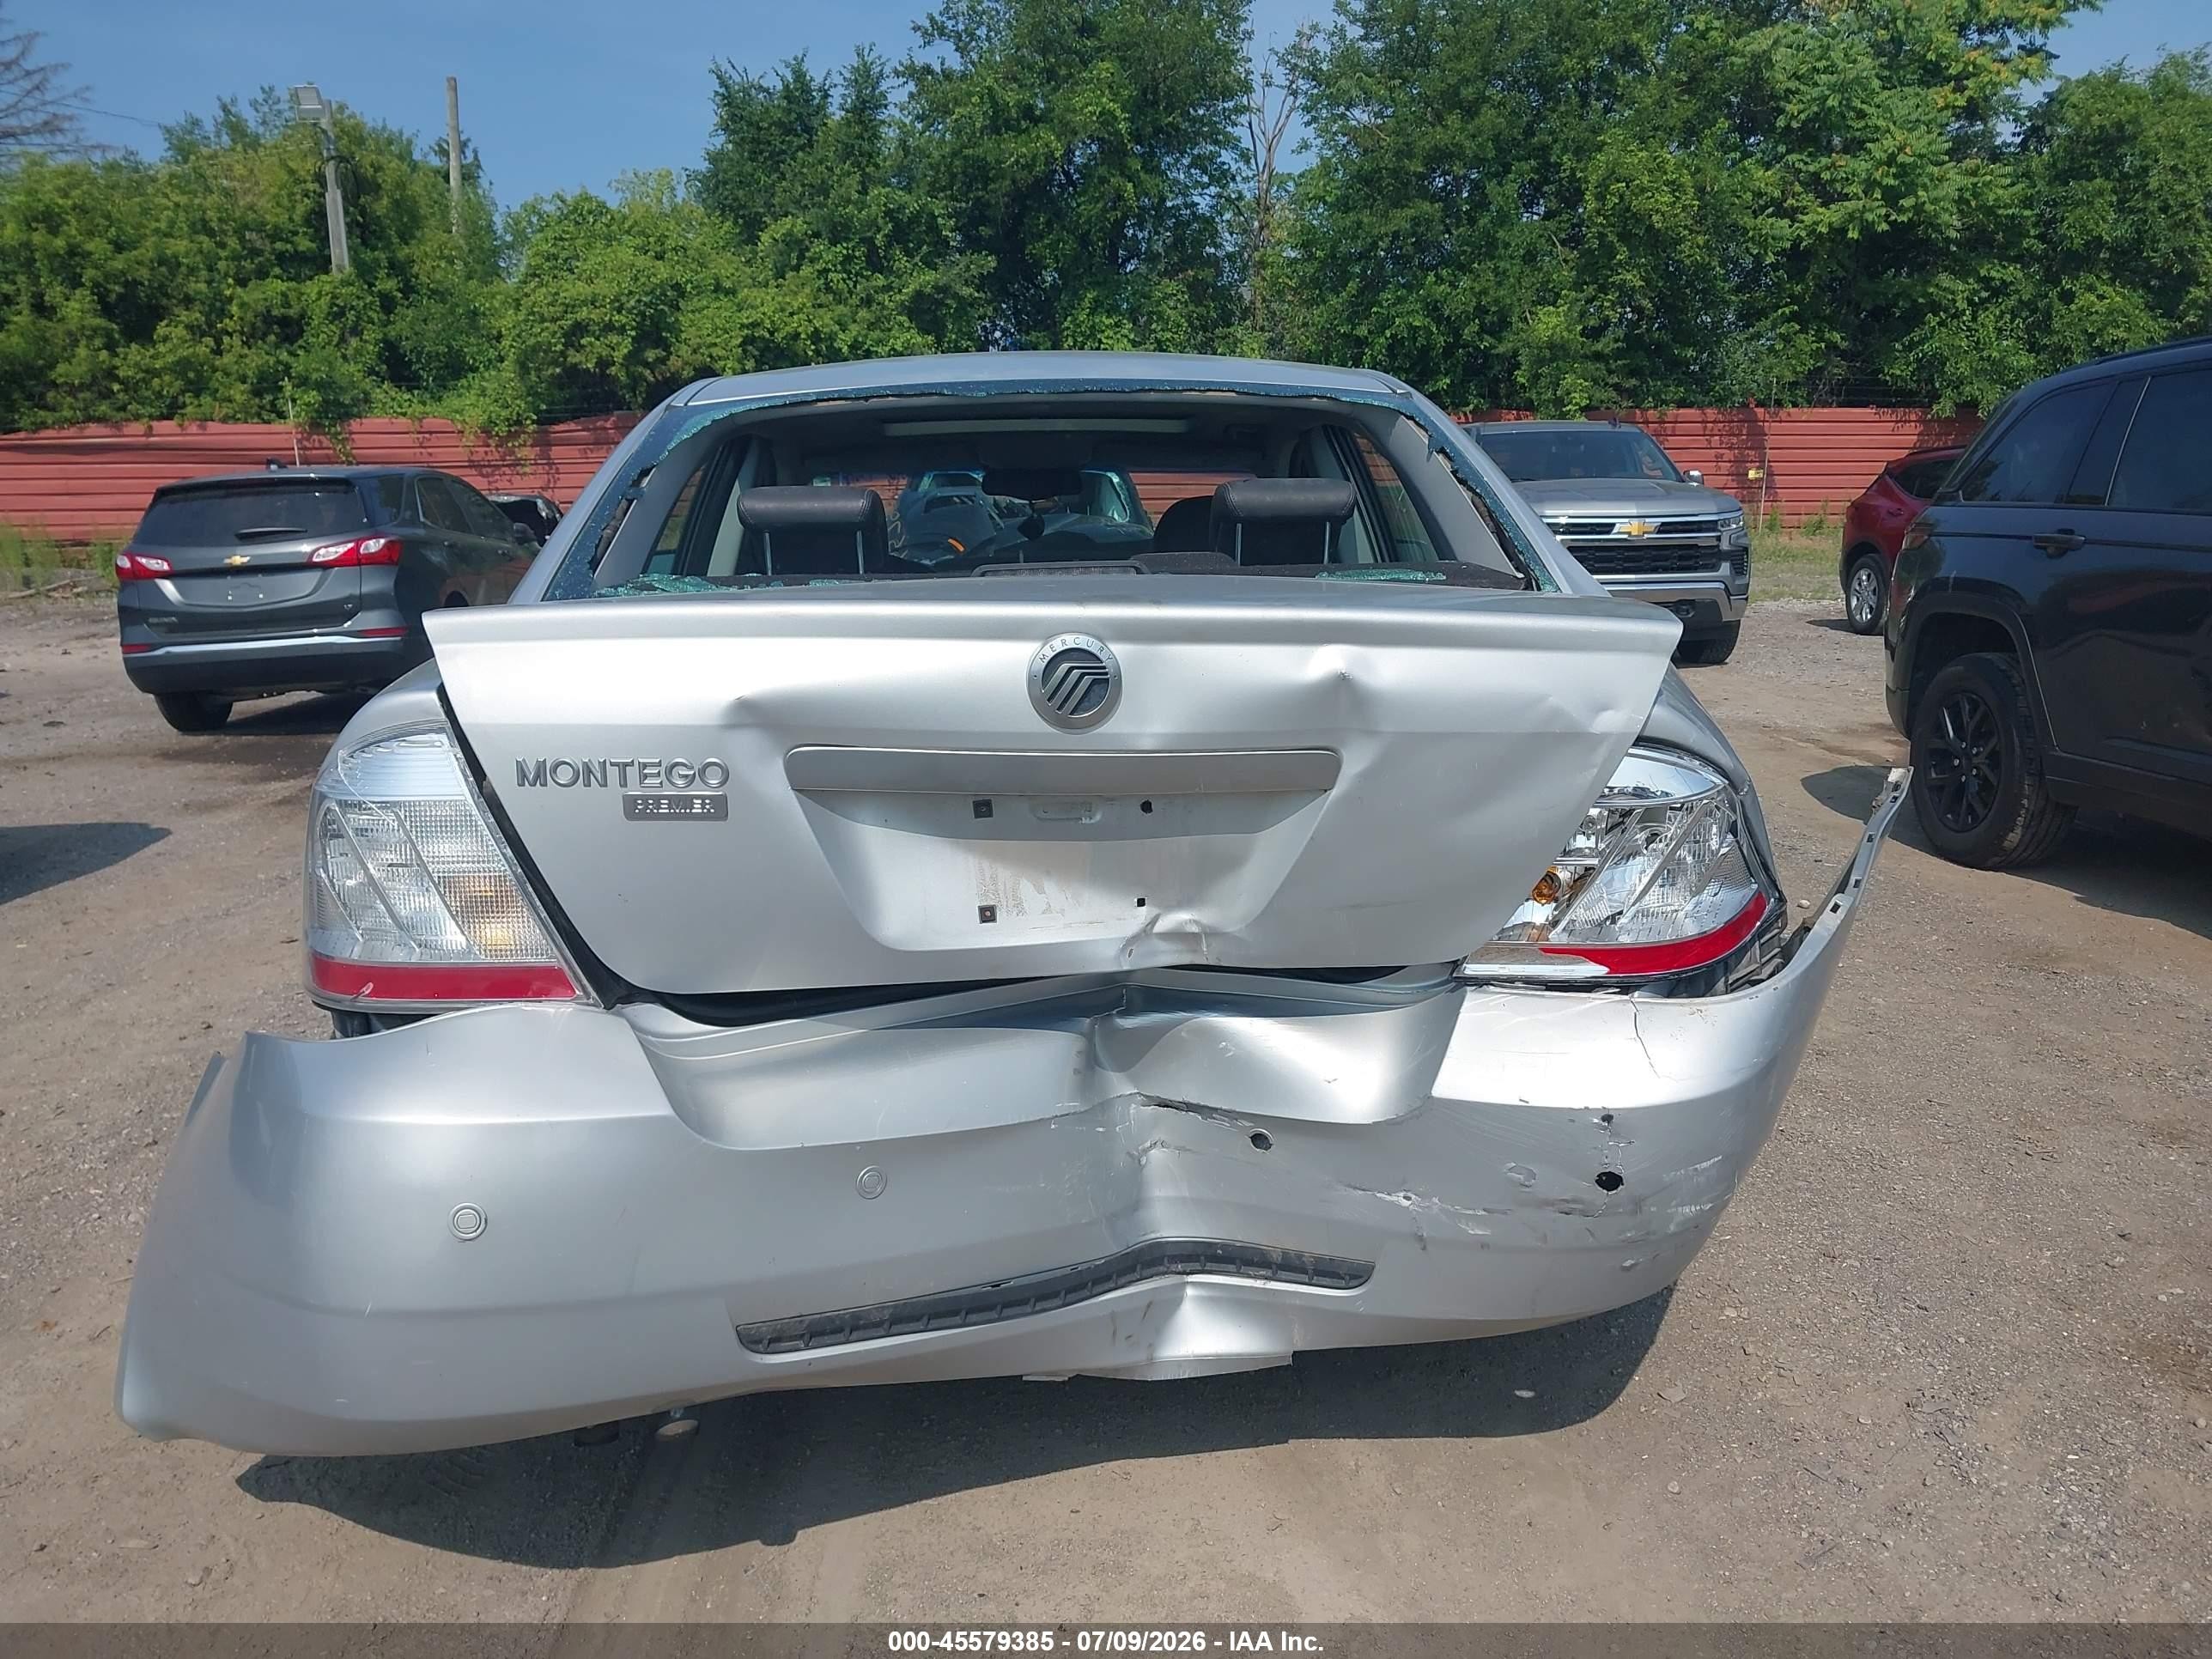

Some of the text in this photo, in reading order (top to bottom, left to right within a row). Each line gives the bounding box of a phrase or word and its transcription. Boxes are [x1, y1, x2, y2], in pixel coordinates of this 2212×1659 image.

[1038, 636, 1114, 664] MERCURY
[514, 756, 730, 788] MONTEGO
[634, 797, 715, 814] PREMIER
